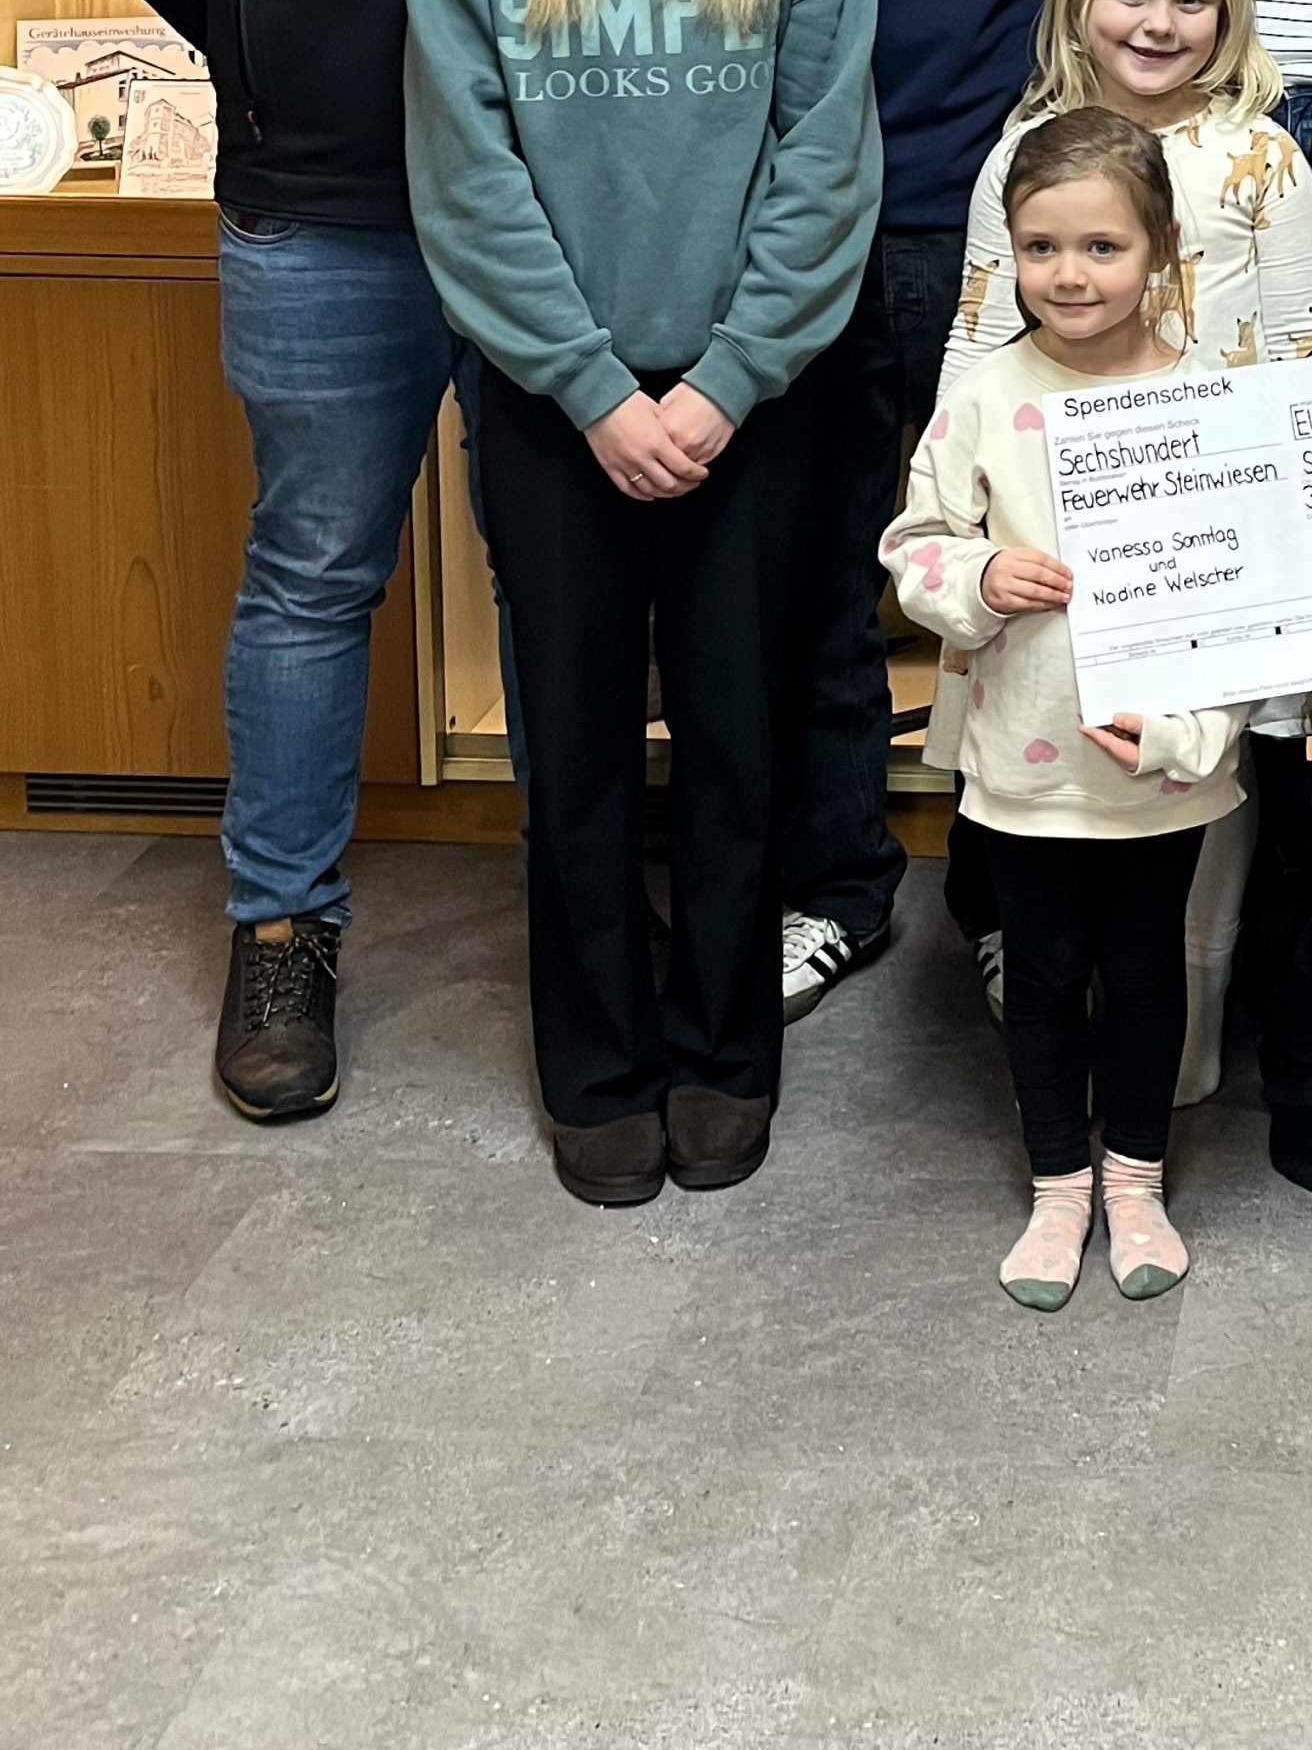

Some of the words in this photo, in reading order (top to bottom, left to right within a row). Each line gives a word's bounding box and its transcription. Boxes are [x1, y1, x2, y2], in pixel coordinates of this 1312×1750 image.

[28, 25, 166, 39] Gerätehauseinweihung
[515, 67, 671, 101] LOOKS
[685, 60, 770, 95] GOO
[1064, 376, 1234, 420] Spendenscheck
[1058, 429, 1200, 476] Sechshundert
[1061, 476, 1159, 512] Feuerwehr
[1164, 462, 1278, 497] Steinwiesen
[1087, 539, 1164, 563] Vanessa
[1171, 526, 1240, 551] Sonntag
[1149, 556, 1178, 573] und
[1093, 582, 1157, 606] Nadine
[1164, 565, 1245, 593] Welscher
